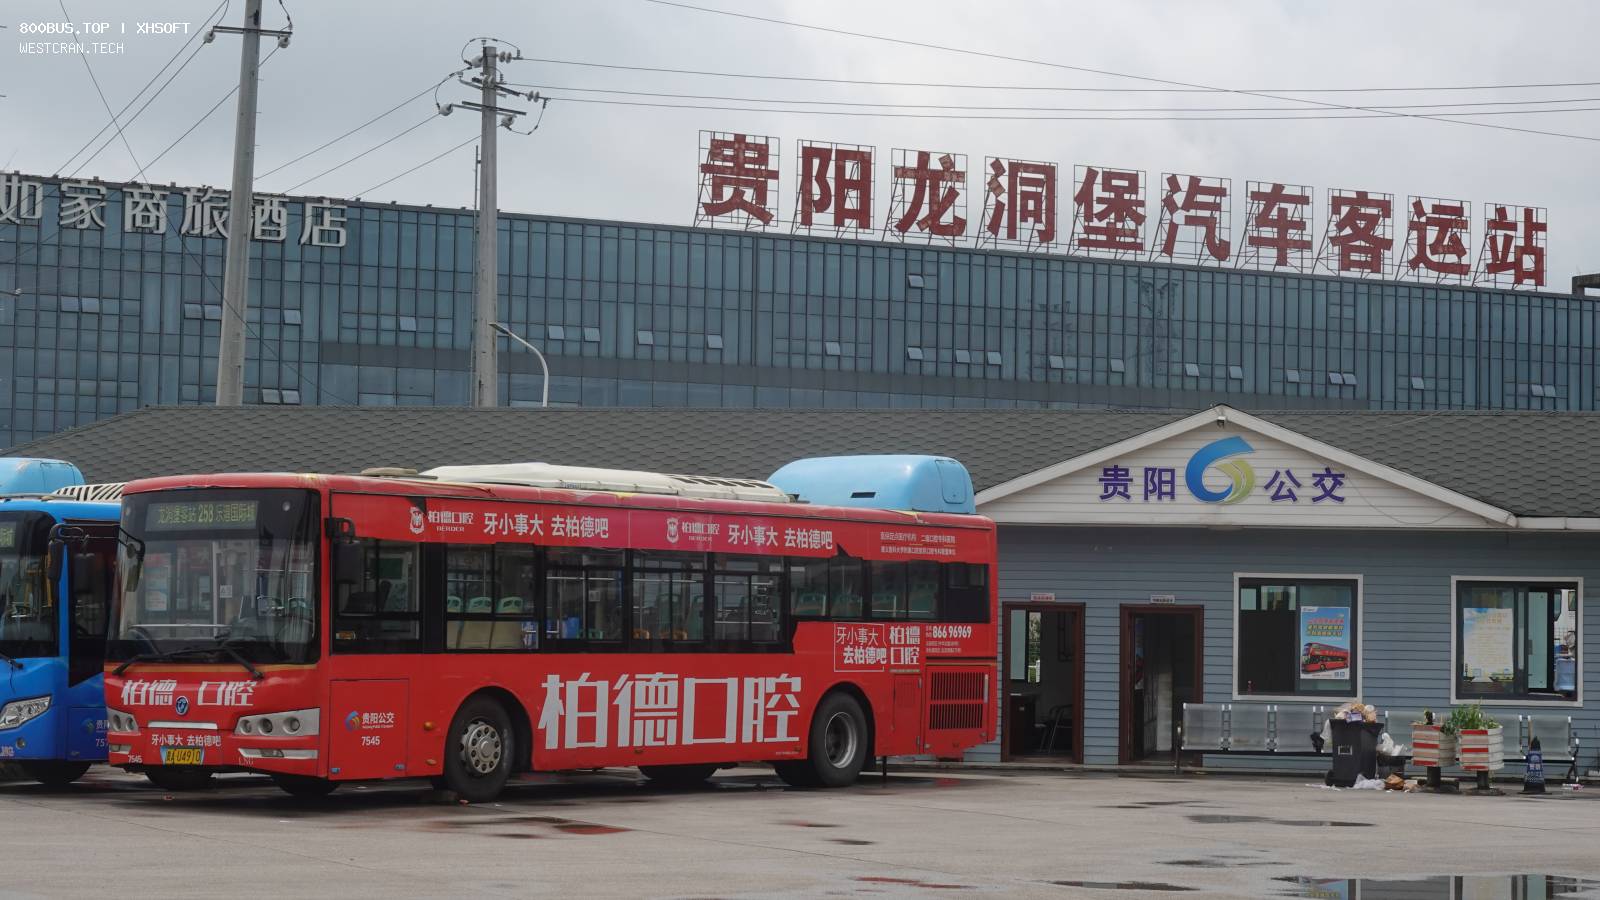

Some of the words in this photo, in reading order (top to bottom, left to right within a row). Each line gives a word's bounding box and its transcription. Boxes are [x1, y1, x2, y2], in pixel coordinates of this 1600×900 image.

[0, 174, 348, 248] 如家商旅酒店
[701, 134, 1545, 287] 贵阳龙洞堡汽车客运站
[1099, 465, 1176, 501] 贵阳
[1263, 467, 1346, 502] 公交
[198, 503, 214, 522] 258
[483, 512, 544, 537] 牙小事大
[551, 514, 609, 539] 去柏德吧
[727, 524, 779, 547] 牙小事大
[784, 528, 833, 550] 去柏德吧
[836, 626, 879, 646] 牙小事大
[889, 625, 921, 645] 柏德
[932, 625, 947, 639] 866
[948, 625, 972, 639] 96969
[843, 645, 887, 665] 去柏德吧
[890, 646, 920, 665] 口腔
[120, 679, 177, 706] 柏德
[197, 680, 257, 706] 口腔
[362, 711, 395, 725] 贵阳公交
[537, 671, 802, 750] 柏德口腔
[151, 734, 183, 747] 牙小事大
[187, 734, 222, 747] 去柏德吧
[361, 735, 381, 746] 7545
[127, 754, 143, 763] 7545
